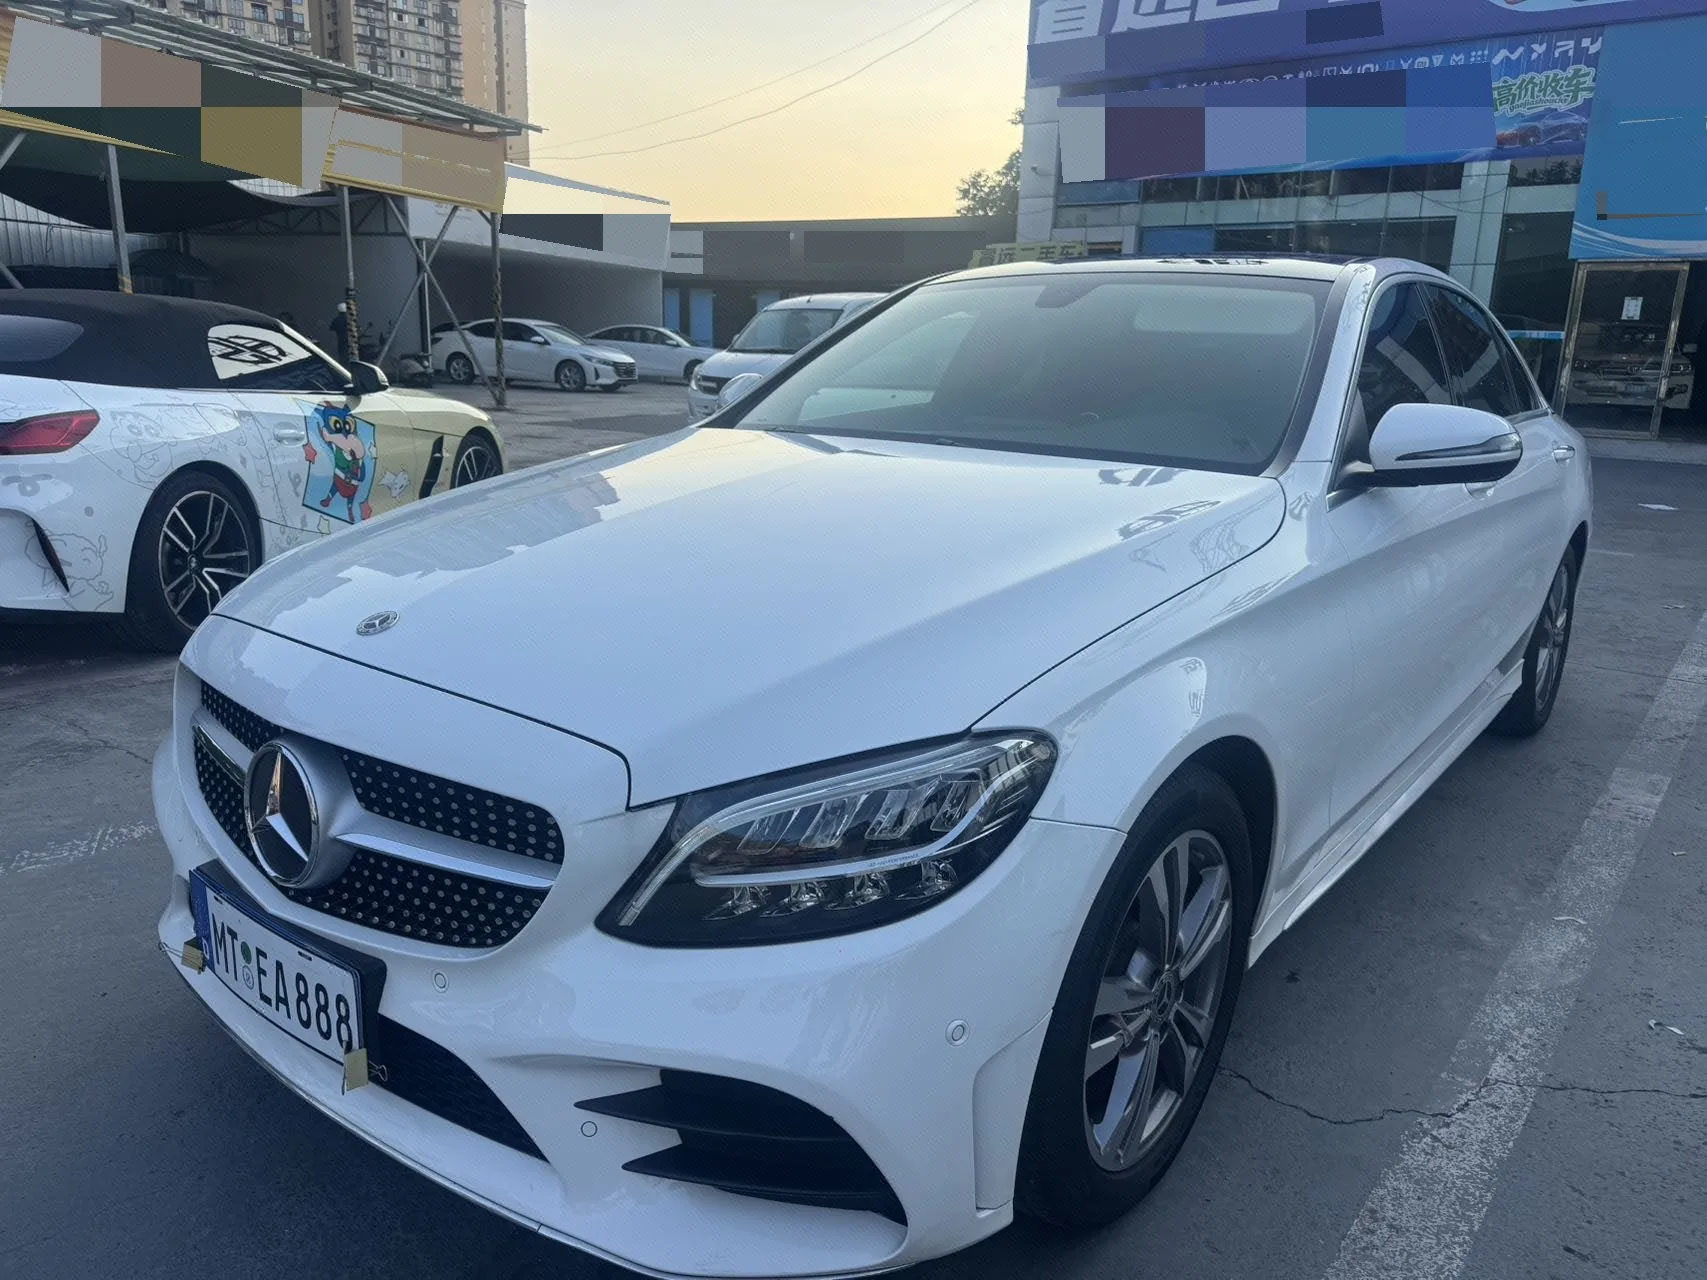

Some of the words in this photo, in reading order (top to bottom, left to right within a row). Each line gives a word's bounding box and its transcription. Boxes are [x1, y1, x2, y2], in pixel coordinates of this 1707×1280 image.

[1493, 67, 1595, 111] 高价收车
[212, 912, 238, 981] MT
[256, 946, 353, 1055] EA888
